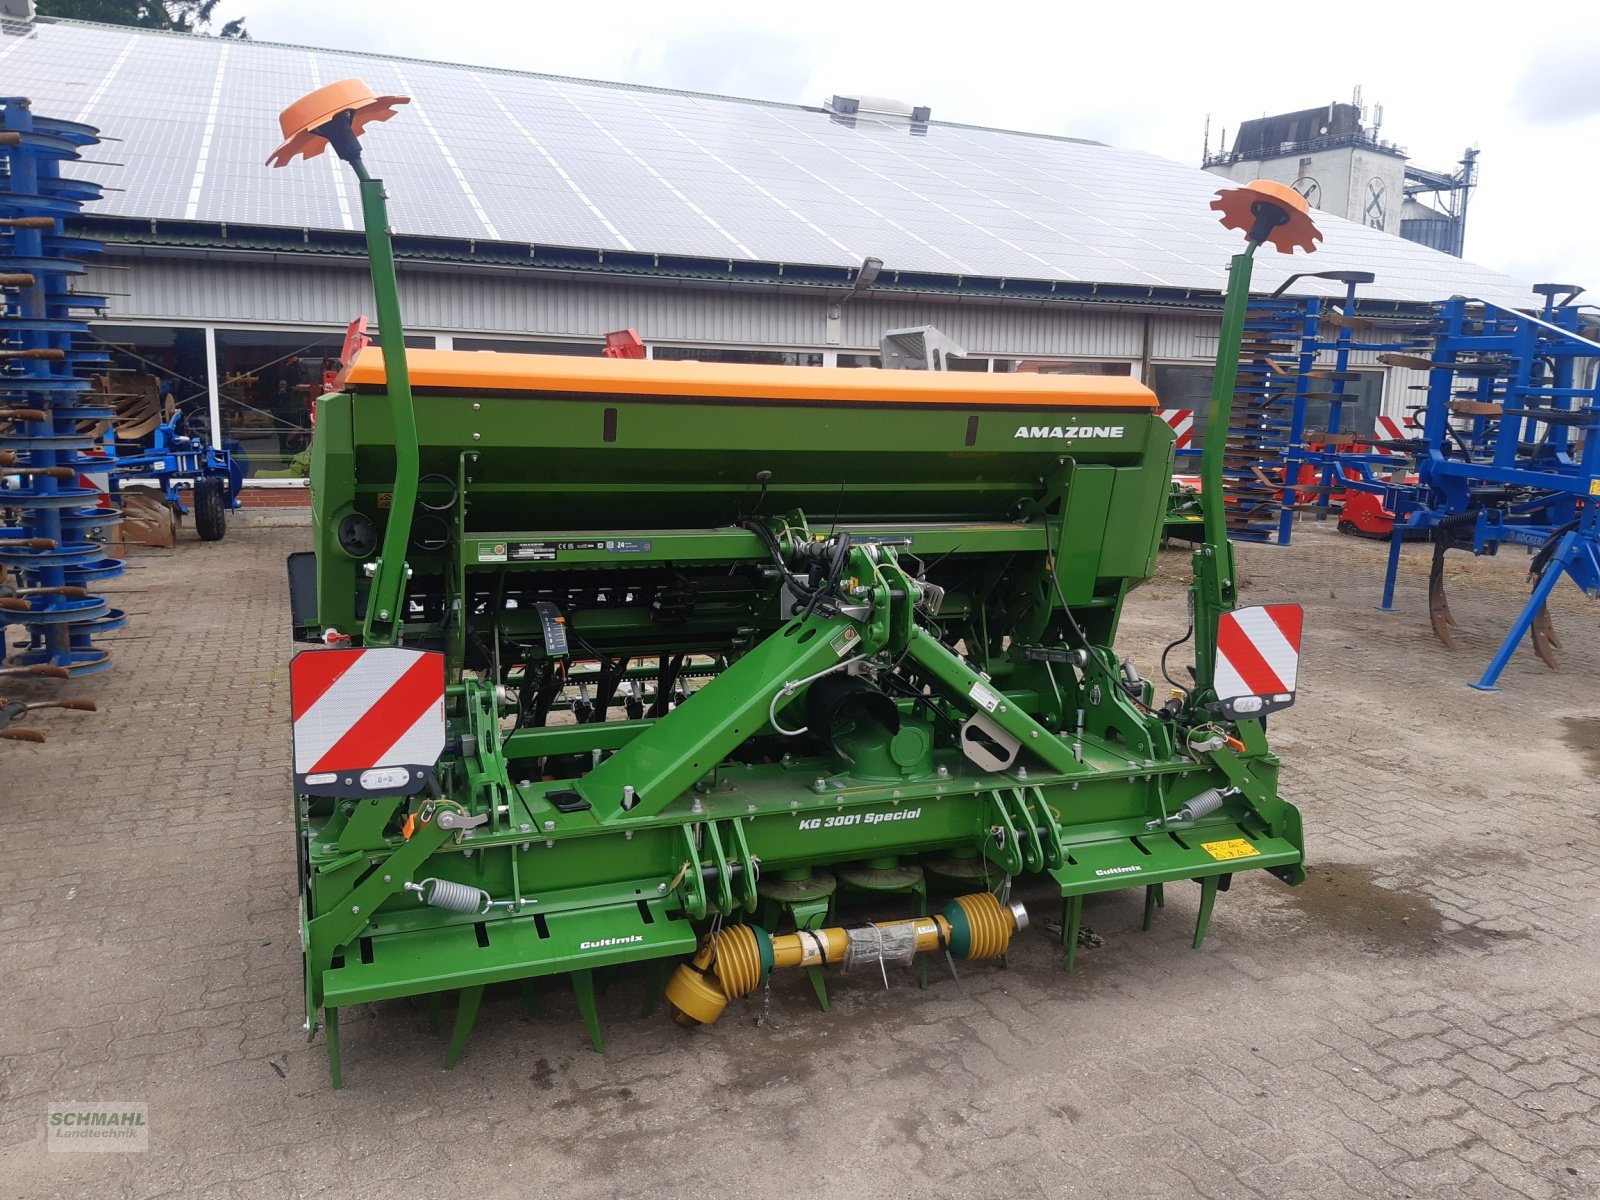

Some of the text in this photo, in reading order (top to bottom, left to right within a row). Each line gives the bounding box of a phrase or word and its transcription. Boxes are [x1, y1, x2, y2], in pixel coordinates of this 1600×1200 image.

[1014, 426, 1124, 438] AMAZONE
[799, 808, 922, 830] KG 3001 Special
[1095, 865, 1142, 876] Cultimix
[580, 935, 643, 950] Cultimix
